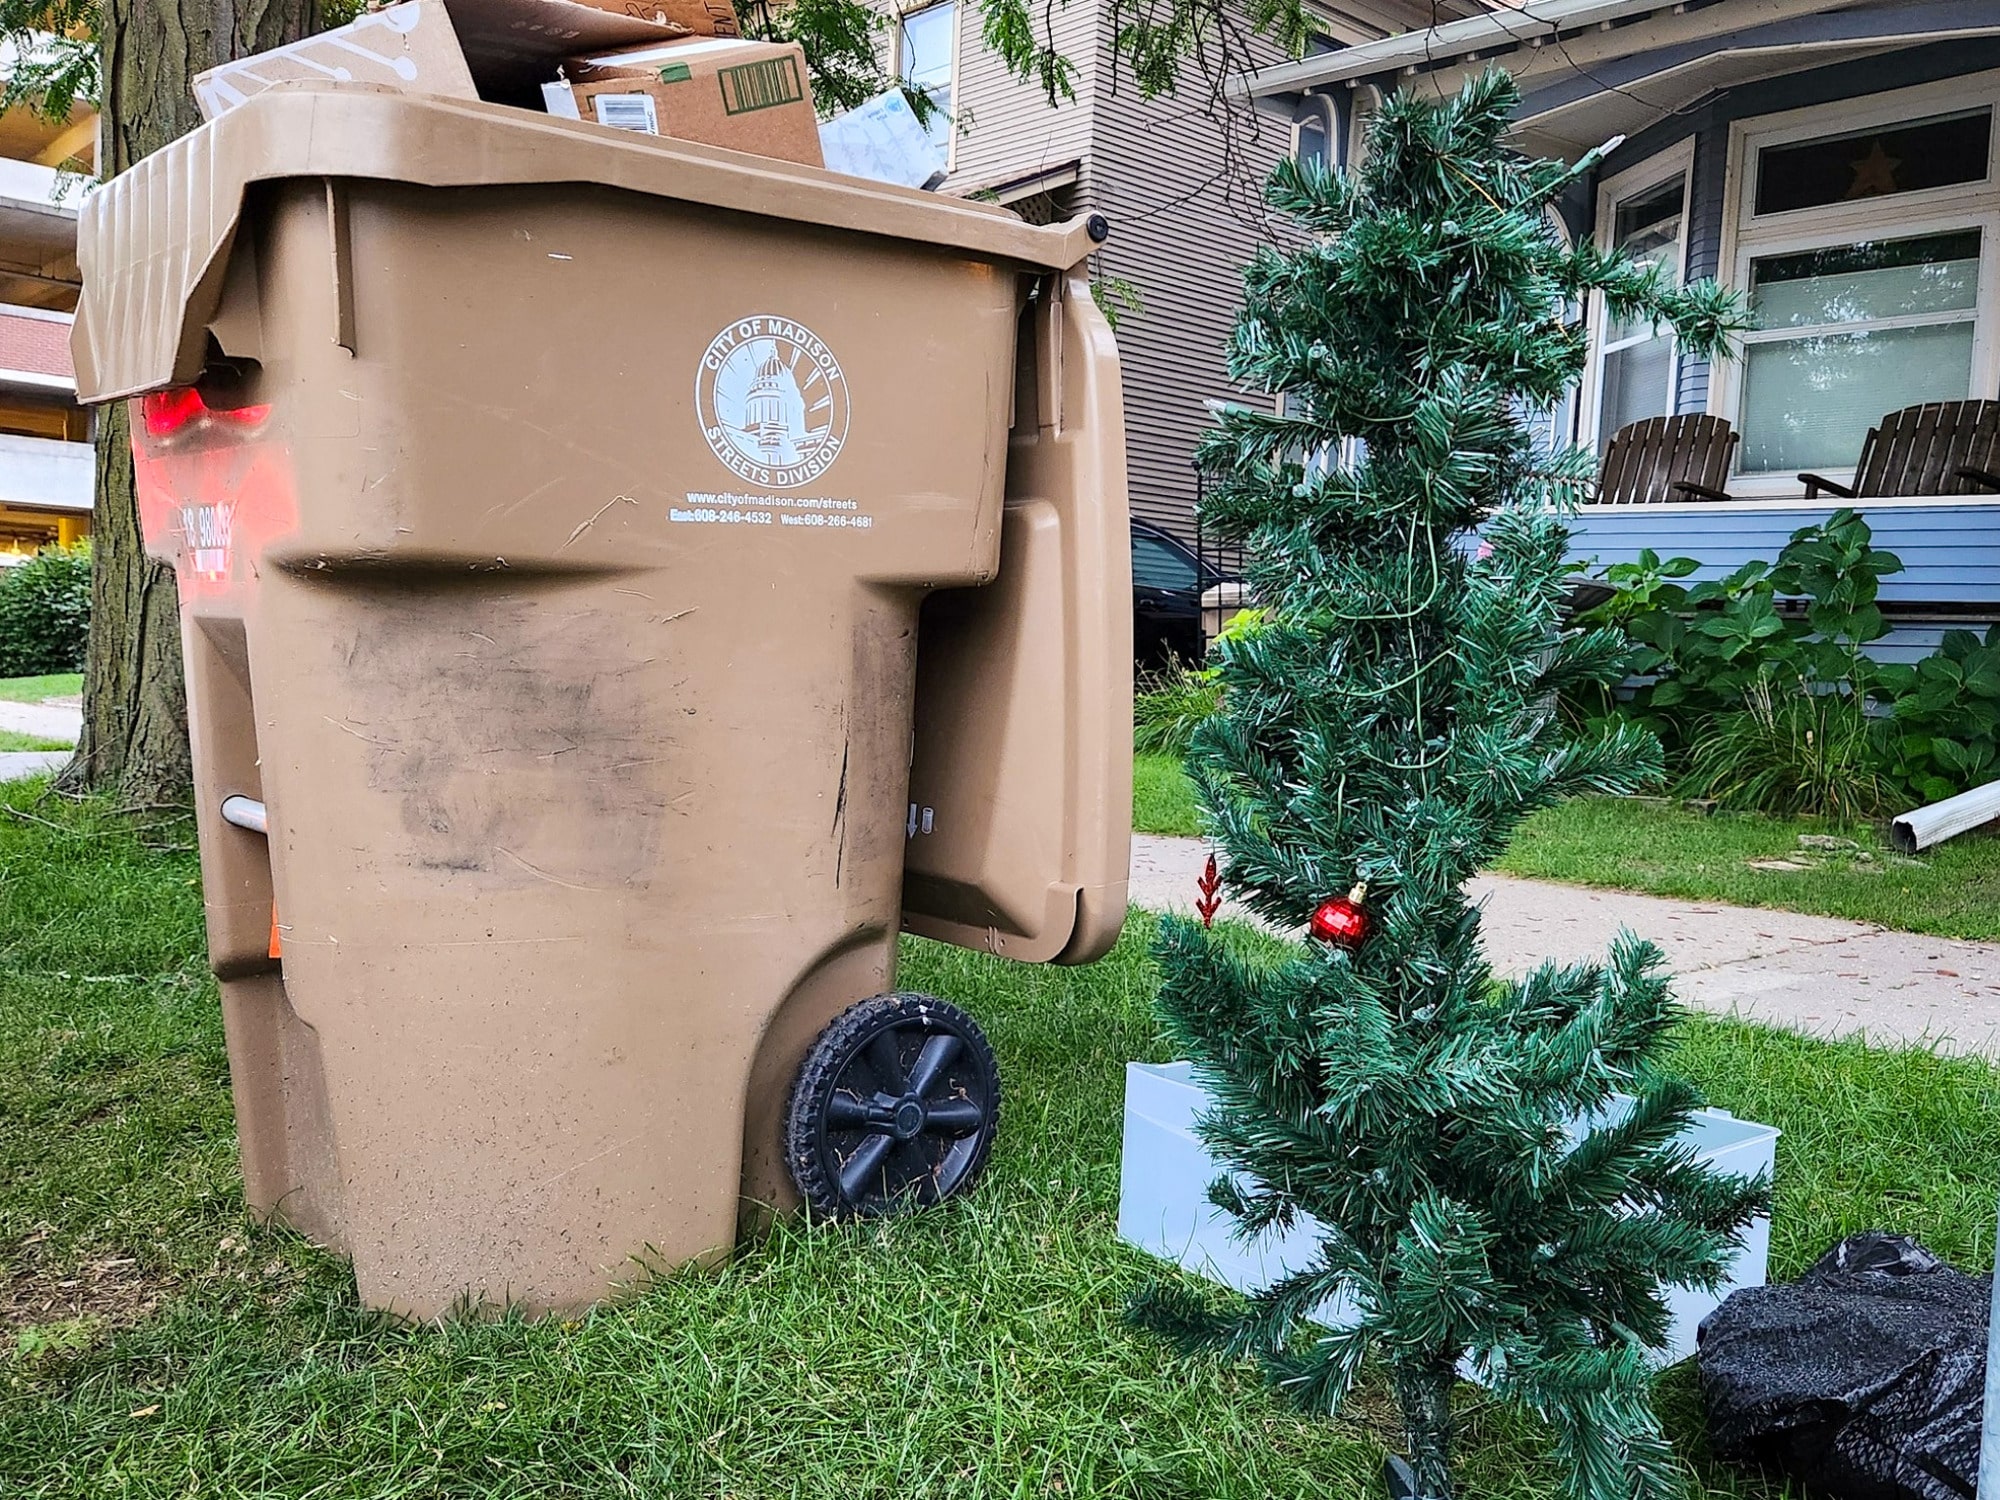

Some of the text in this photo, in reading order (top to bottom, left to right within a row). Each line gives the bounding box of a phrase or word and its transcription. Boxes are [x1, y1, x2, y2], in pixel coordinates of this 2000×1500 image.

[706, 319, 840, 381] CITY OF MADISON
[707, 426, 841, 485] STREETS DIVISION
[686, 492, 858, 510] www.cityofmadison.com/streets
[780, 513, 873, 528] West:608-266-4681
